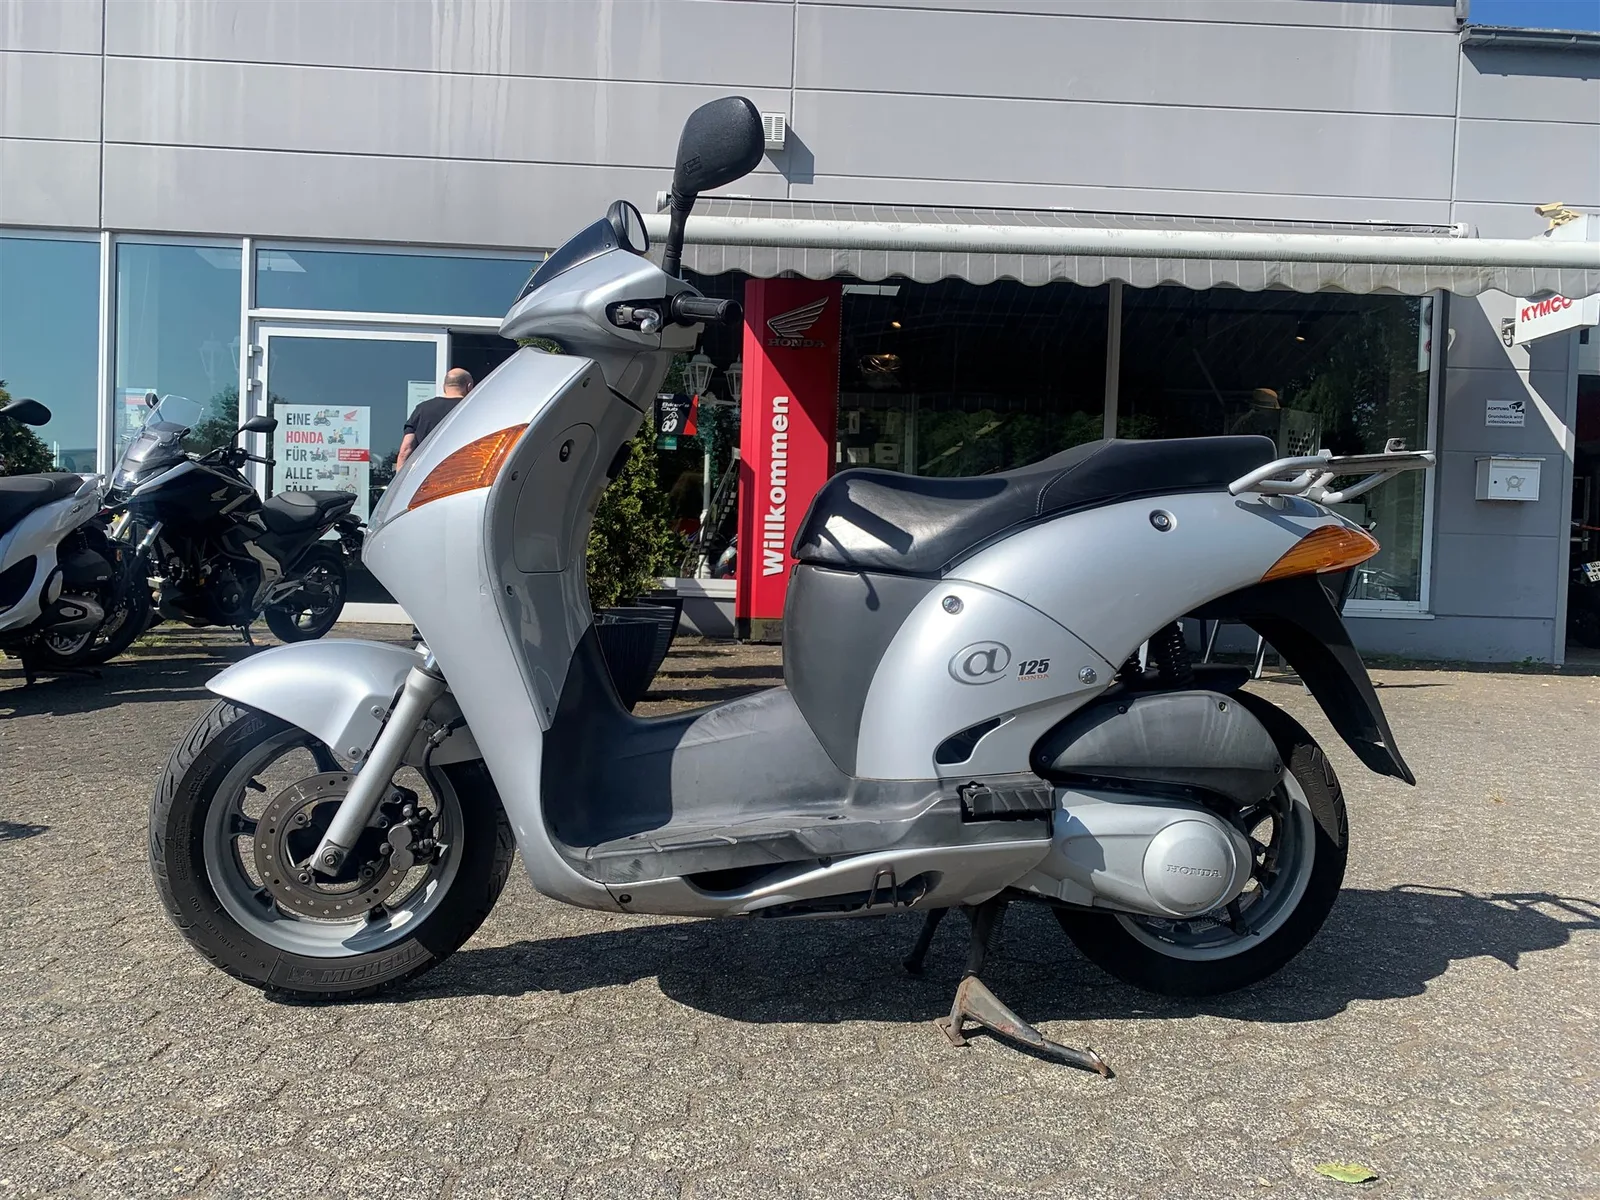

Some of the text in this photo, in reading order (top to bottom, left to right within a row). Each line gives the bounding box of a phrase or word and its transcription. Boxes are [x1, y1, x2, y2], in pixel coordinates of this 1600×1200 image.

[1521, 296, 1573, 323] KYMCO
[767, 338, 826, 347] HONDA
[286, 412, 311, 426] EINE
[286, 430, 324, 444] HONDA
[285, 445, 308, 461] FÜR
[285, 467, 313, 480] ALLE
[762, 396, 789, 576] Willkommen
[1018, 658, 1051, 676] 125
[1017, 674, 1050, 682] HONDA
[1166, 864, 1222, 878] HONDA
[319, 943, 425, 983] MICHELIN
